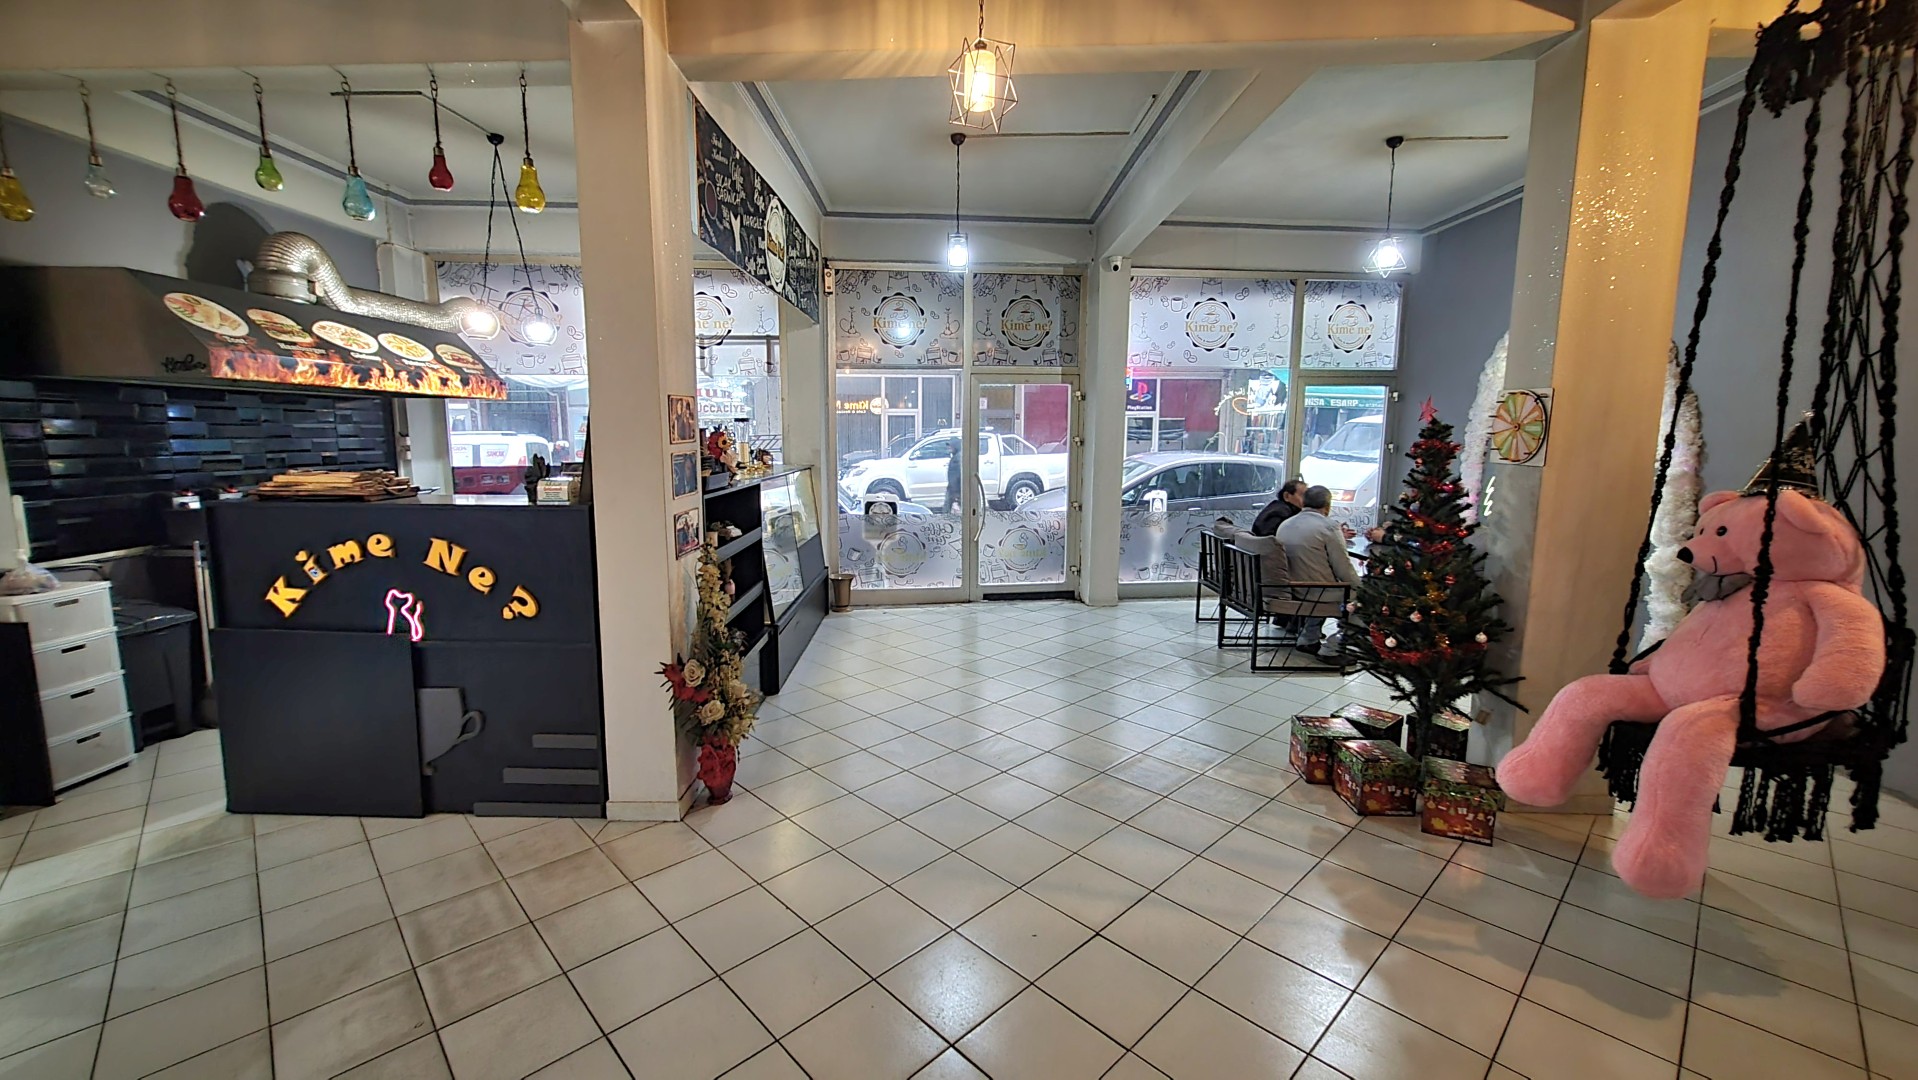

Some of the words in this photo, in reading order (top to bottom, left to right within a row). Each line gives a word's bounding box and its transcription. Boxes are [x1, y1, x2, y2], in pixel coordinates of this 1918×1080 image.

[873, 317, 905, 329] Kime
[1001, 319, 1031, 331] Kime
[1034, 320, 1053, 331] ne?
[1185, 321, 1216, 332] Kime
[1219, 321, 1239, 333] ne?
[1327, 324, 1355, 335] Kime
[1358, 324, 1375, 335] ne?
[264, 533, 397, 618] Kime
[422, 537, 541, 620] Ne?
